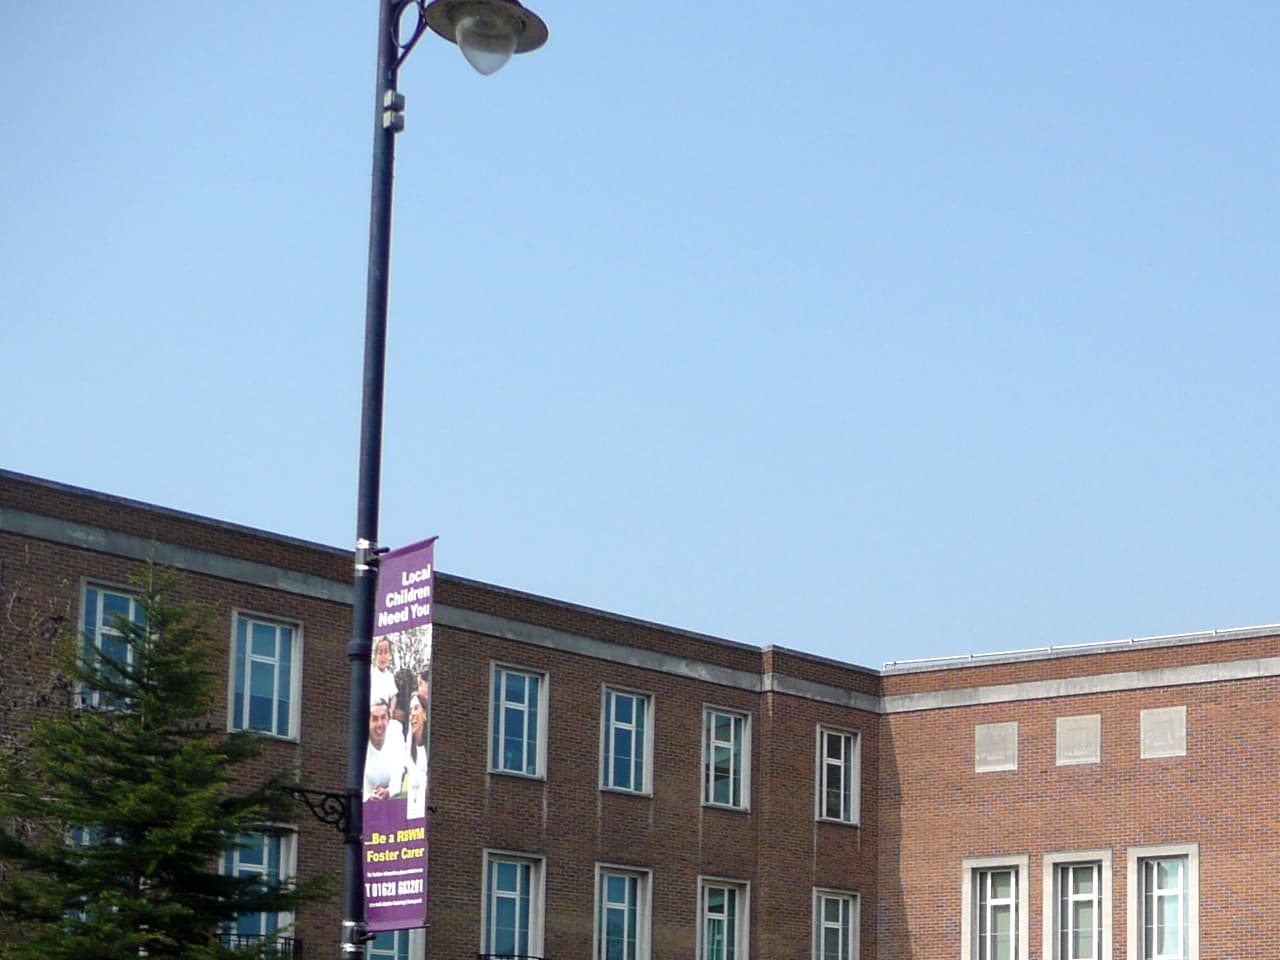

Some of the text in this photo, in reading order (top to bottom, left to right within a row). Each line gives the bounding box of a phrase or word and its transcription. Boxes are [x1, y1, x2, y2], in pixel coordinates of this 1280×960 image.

[402, 564, 431, 586] Local
[386, 586, 430, 608] Children
[378, 603, 430, 627] Need You
[388, 834, 395, 843] a
[367, 848, 425, 862] Foster Carer
[364, 883, 371, 897] T
[372, 881, 396, 897] 01628
